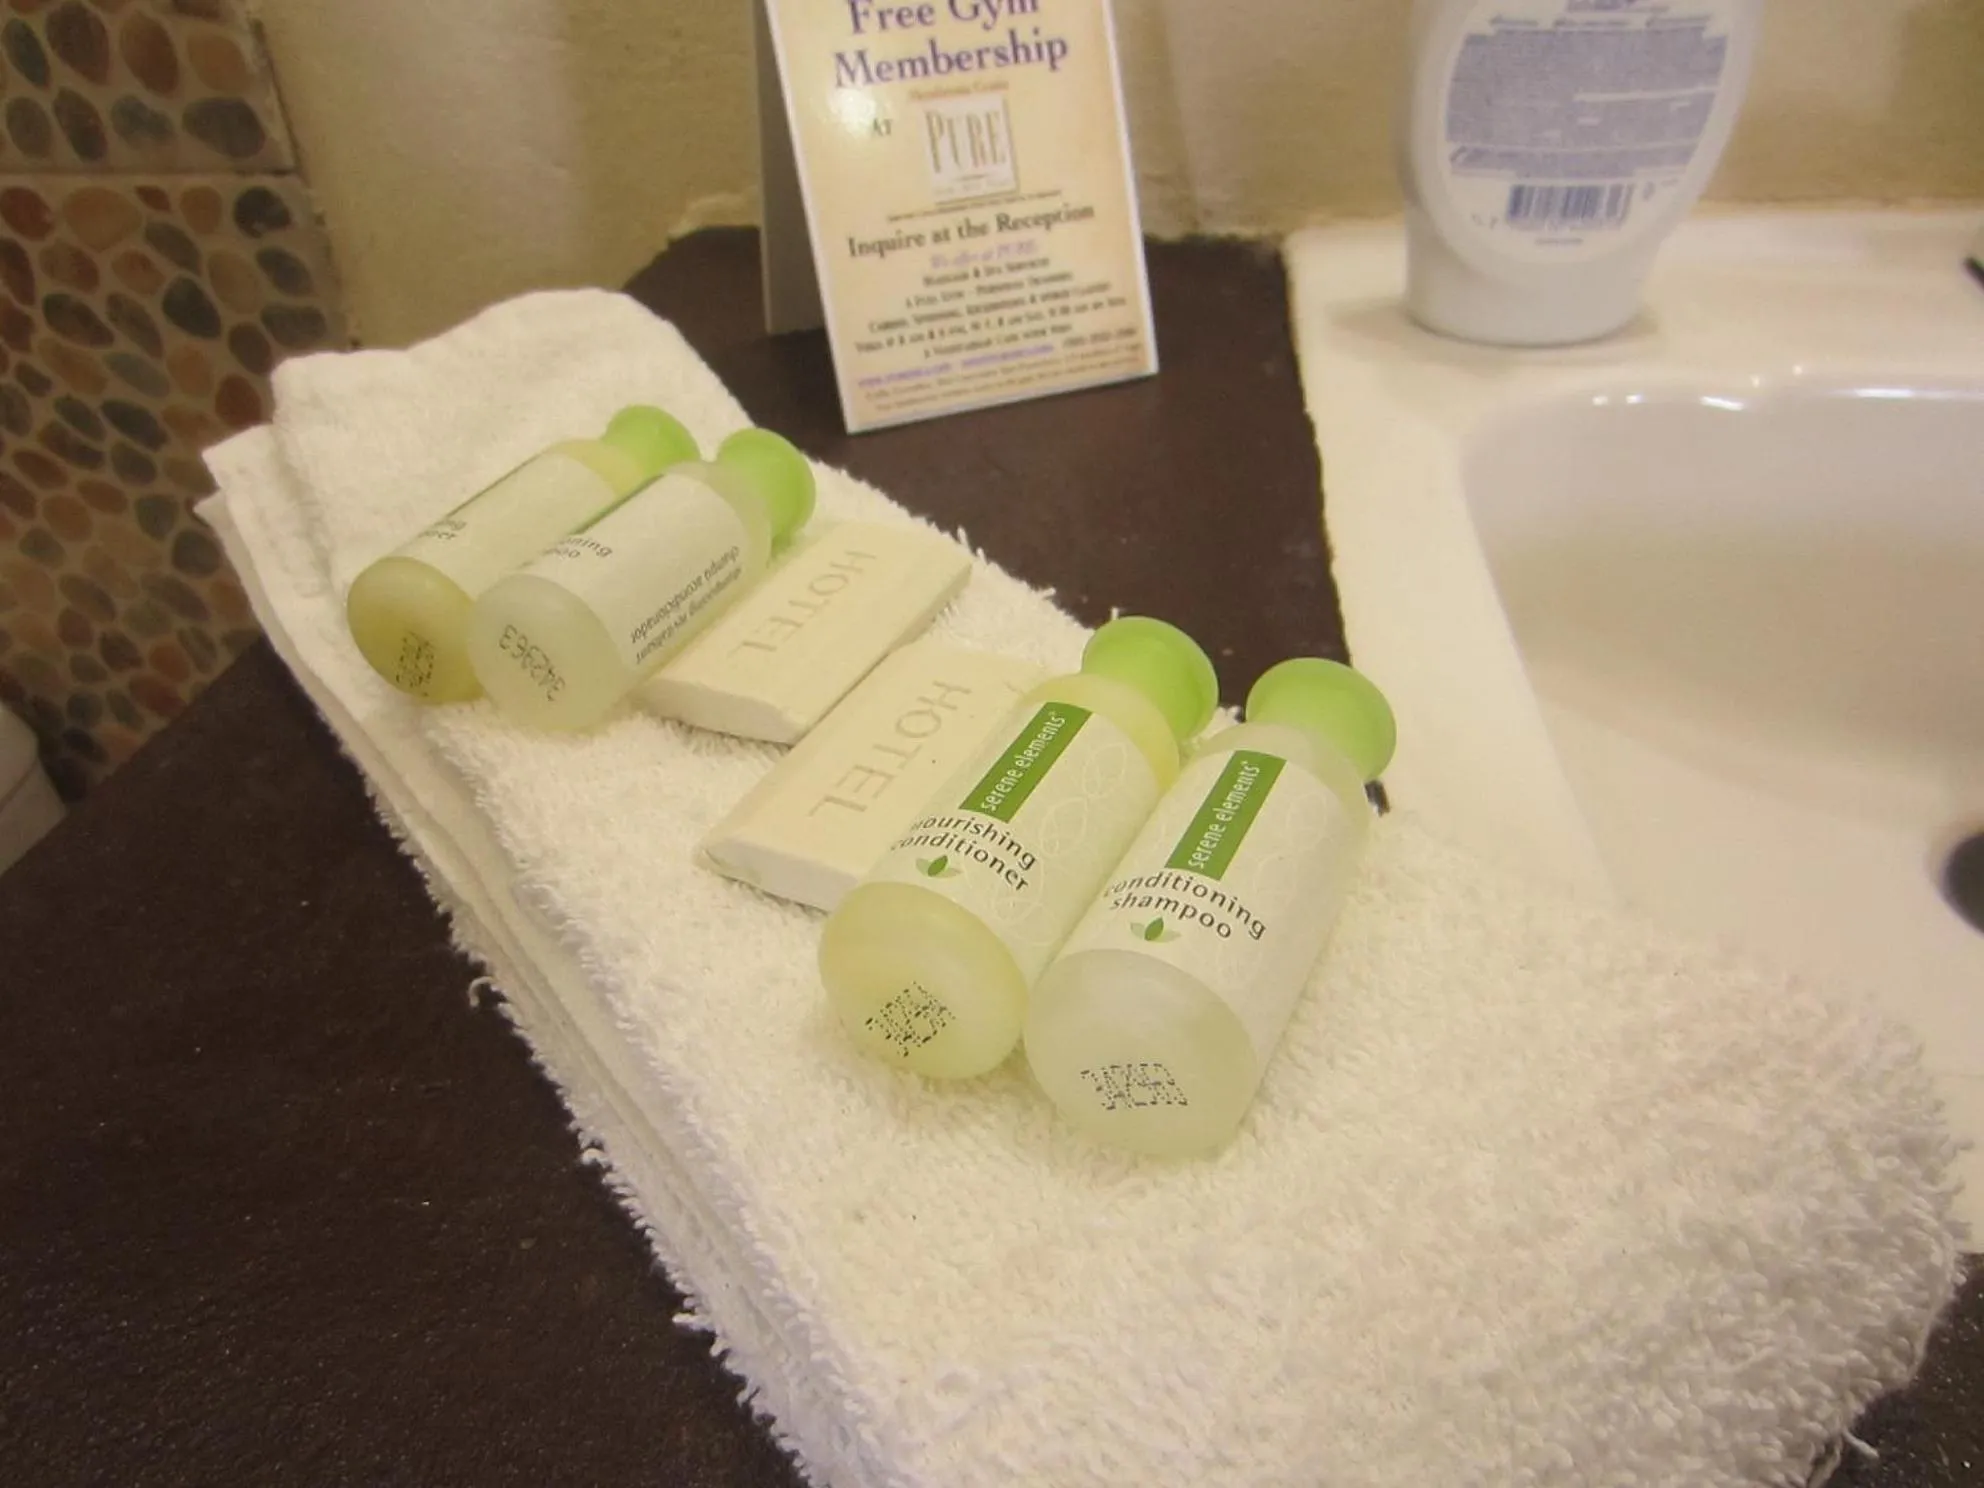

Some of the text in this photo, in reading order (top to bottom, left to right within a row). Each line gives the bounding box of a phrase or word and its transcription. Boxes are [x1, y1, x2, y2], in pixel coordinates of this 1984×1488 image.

[848, 0, 1040, 34] Free Gym
[834, 26, 1069, 89] Membership
[924, 107, 1008, 174] PURE
[847, 229, 926, 259] Inquire
[931, 227, 951, 244] at
[957, 217, 990, 240] the
[995, 203, 1095, 232] Reception
[728, 549, 876, 656] HOTEL
[809, 679, 973, 818] HOTEL
[981, 769, 1024, 812] serene
[1188, 823, 1227, 869] serene
[1109, 891, 1232, 939] shampoo
